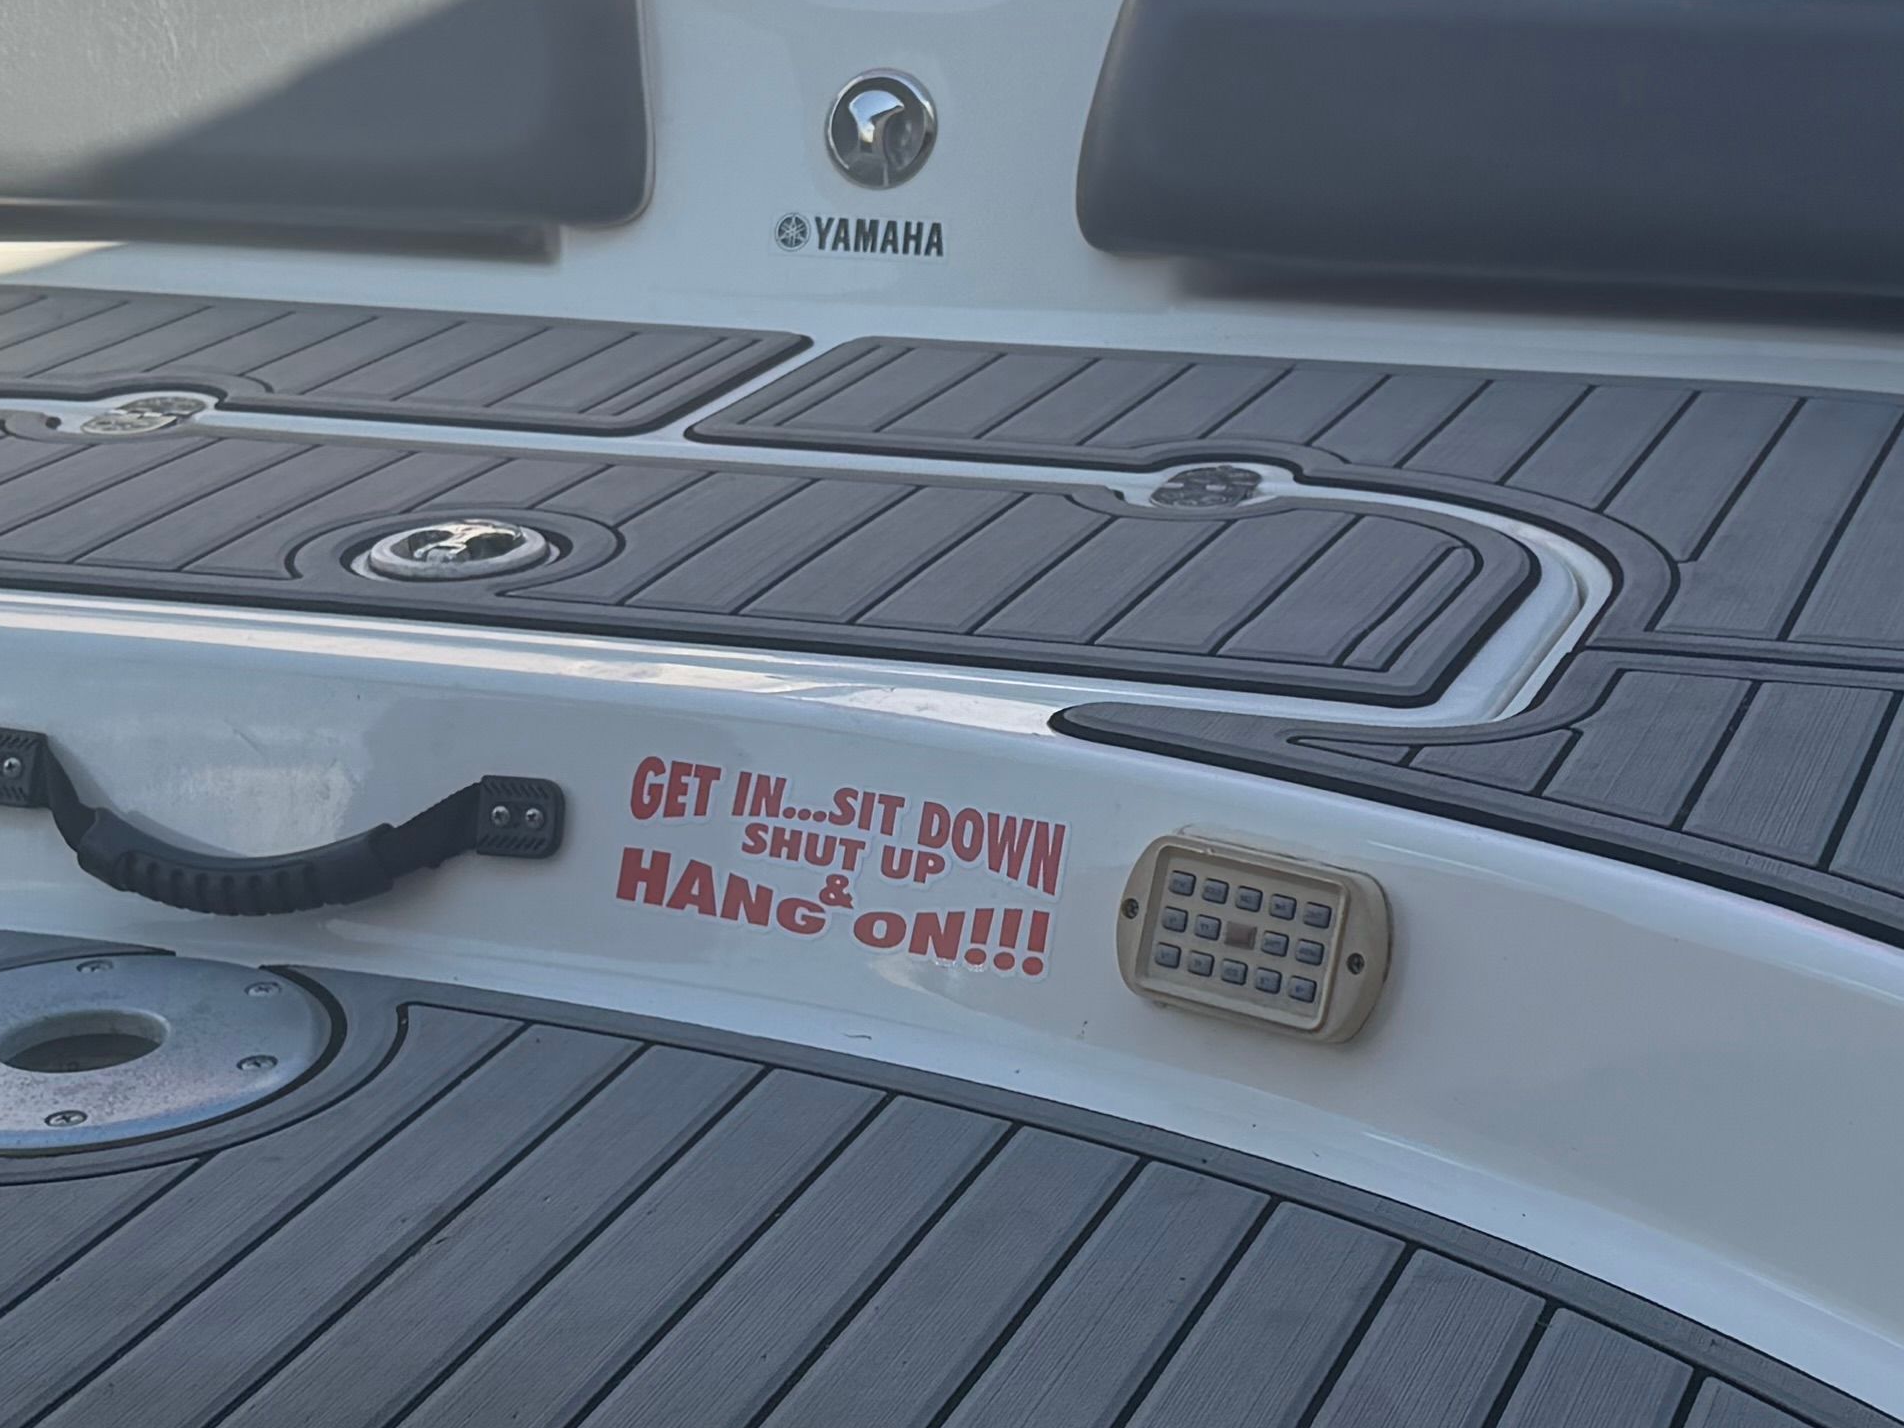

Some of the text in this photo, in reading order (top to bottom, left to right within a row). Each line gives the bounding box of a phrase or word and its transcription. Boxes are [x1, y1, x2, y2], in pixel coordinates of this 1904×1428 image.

[814, 216, 944, 257] YAMAHA
[630, 756, 722, 820] GET
[917, 801, 1066, 896] DOWN
[741, 823, 946, 884] SHUT UP
[616, 847, 1051, 976] HANG ON!!!
[819, 874, 854, 909] &
